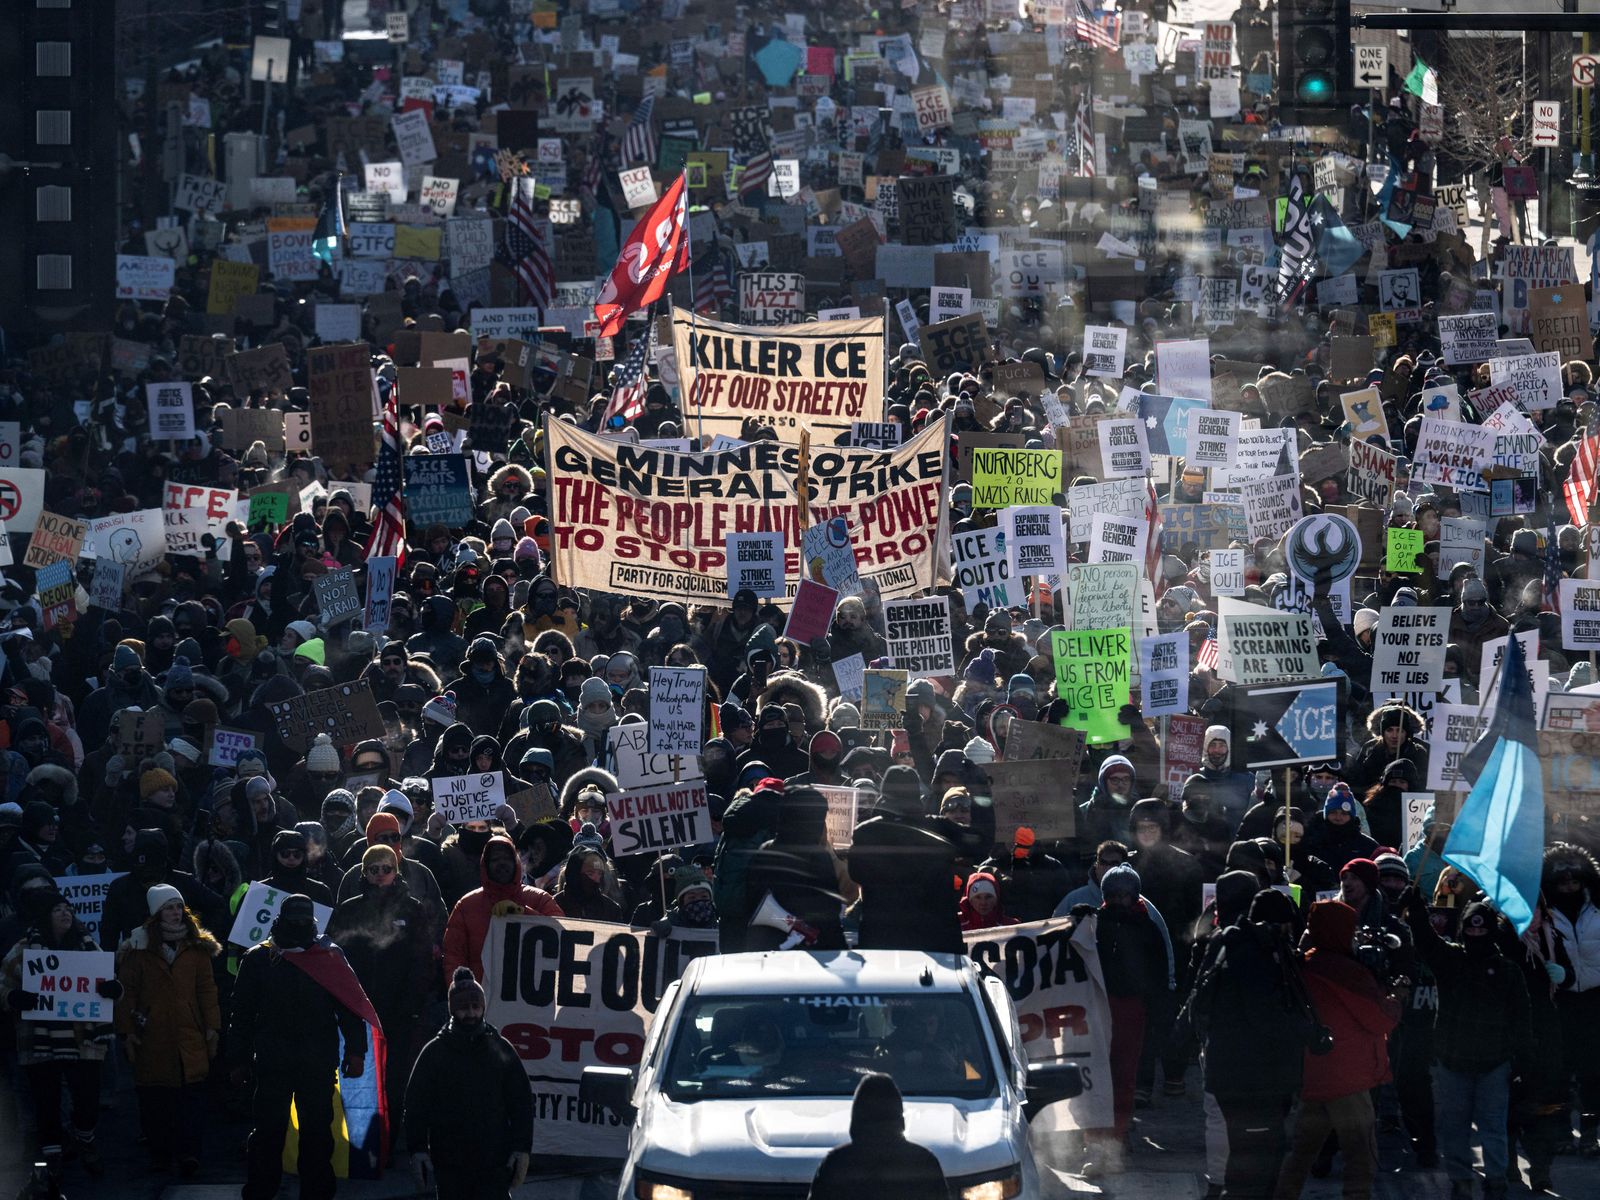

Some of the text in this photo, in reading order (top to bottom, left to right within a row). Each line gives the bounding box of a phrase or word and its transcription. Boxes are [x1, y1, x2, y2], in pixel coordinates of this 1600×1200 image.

[1206, 24, 1232, 39] NO
[1206, 40, 1232, 49] KINGS
[1204, 51, 1230, 66] NO
[1360, 49, 1383, 58] ONE
[1204, 66, 1230, 79] ICE
[1359, 60, 1384, 70] WAY
[917, 92, 942, 112] ICE
[919, 110, 948, 126] OUT!
[1540, 106, 1553, 117] NO
[1534, 121, 1558, 131] STOPPING
[374, 167, 391, 177] NO
[622, 170, 649, 187] FUCK
[432, 180, 450, 190] NO
[902, 181, 952, 200] WHAT
[188, 196, 216, 210] ICE
[429, 199, 446, 209] NO
[1435, 188, 1466, 206] FUCK
[551, 200, 580, 212] ICE
[907, 201, 943, 212] THE
[361, 224, 385, 234] ICE
[456, 231, 487, 243] CHILD
[1013, 253, 1047, 267] ICE
[1504, 249, 1570, 261] MAKE AMERICA
[1508, 261, 1570, 278] GREAT AGAIN
[742, 274, 785, 291] THIS
[744, 292, 795, 308] NAZI
[938, 300, 962, 309] GENERAL
[482, 313, 536, 322] AND THEN
[1538, 316, 1580, 334] PRETTI
[927, 321, 982, 347] ICE
[1093, 332, 1119, 340] EXPAND THE
[1454, 330, 1495, 340] ANYWHERE
[1092, 340, 1118, 349] GENERAL
[1541, 337, 1581, 356] GOOD
[689, 332, 866, 378] KILLER ICE
[1492, 355, 1558, 373] IMMIGRANTS
[1510, 371, 1538, 380] MAKE
[689, 373, 867, 417] OFF OUR STREETS!
[1198, 416, 1230, 426] EXPAND THE
[429, 433, 446, 442] ICE
[858, 423, 896, 440] KILLER
[1110, 426, 1135, 436] JUSTICE
[1198, 425, 1229, 436] GENERAL
[1110, 436, 1139, 447] FOR ALEX
[1199, 441, 1226, 452] STRIKE!
[417, 460, 448, 470] ICE
[617, 444, 893, 478] MINNESOTA
[1352, 441, 1395, 482] SHAME
[1429, 451, 1474, 470] WARM
[411, 471, 456, 484] AGENTS
[555, 445, 942, 502] GENERAL STRIKE
[1455, 470, 1487, 489] ICE
[420, 485, 446, 495] ARE
[974, 485, 1055, 505] NAZIS RAUS!
[1073, 481, 1138, 501] SILENCE
[1070, 496, 1146, 519] NEUTRALITY
[1248, 494, 1285, 510] IT SOUNDS
[555, 477, 609, 526] THE
[616, 495, 728, 548] PEOPLE
[1015, 514, 1050, 524] EXPAND THE
[1256, 509, 1291, 522] LIKE WHEN
[40, 516, 84, 539] NO ONE
[95, 514, 145, 533] ABOLISH ICE
[1015, 523, 1051, 537] GENERAL
[1103, 522, 1124, 532] EXPAND
[1125, 525, 1138, 536] THE
[1102, 530, 1137, 547] GENERAL
[1392, 531, 1417, 540] ICE
[555, 526, 725, 573] TO STOP
[737, 540, 773, 550] EXPAND THE
[956, 534, 990, 562] ICE
[1020, 545, 1051, 557] STRIKE!
[1394, 543, 1414, 551] OUT
[737, 550, 774, 562] GENERAL
[1215, 552, 1239, 568] ICE
[319, 572, 350, 589] WE ARE
[616, 567, 651, 582] PARTY
[652, 570, 674, 587] FOR
[740, 569, 772, 581] STRIKE!
[960, 562, 997, 586] OUT
[40, 590, 54, 608] ICE
[54, 583, 75, 603] OUT
[322, 584, 348, 602] NOT
[887, 601, 948, 621] GENERAL
[888, 619, 949, 640] STRIKE:
[1233, 619, 1308, 638] HISTORY IS
[1392, 615, 1437, 628] BELIEVE
[889, 637, 951, 656] THE PATH TO
[1058, 633, 1128, 657] DELIVER
[1233, 638, 1311, 656] SCREAMING
[1381, 633, 1443, 646] YOUR EYES
[1151, 642, 1177, 658] JUSTICE
[1397, 651, 1420, 664] NOT
[894, 653, 952, 671] JUSTICE
[1151, 658, 1178, 672] FOR ALEX
[1243, 656, 1305, 673] ARE YOU
[1060, 660, 1127, 684] US FROM
[1380, 672, 1429, 684] THE LIES
[652, 671, 702, 692] Hey Trump
[1070, 684, 1116, 710] ICE
[1171, 720, 1204, 735] SALT THE
[1293, 705, 1336, 741] ICE
[638, 752, 687, 777] ICE
[451, 779, 467, 792] NO
[439, 790, 490, 808] JUSTICE
[608, 787, 708, 821] WE WILL NOT BE
[618, 811, 699, 853] SILENT
[27, 953, 60, 977] NO
[501, 922, 595, 1008] ICE
